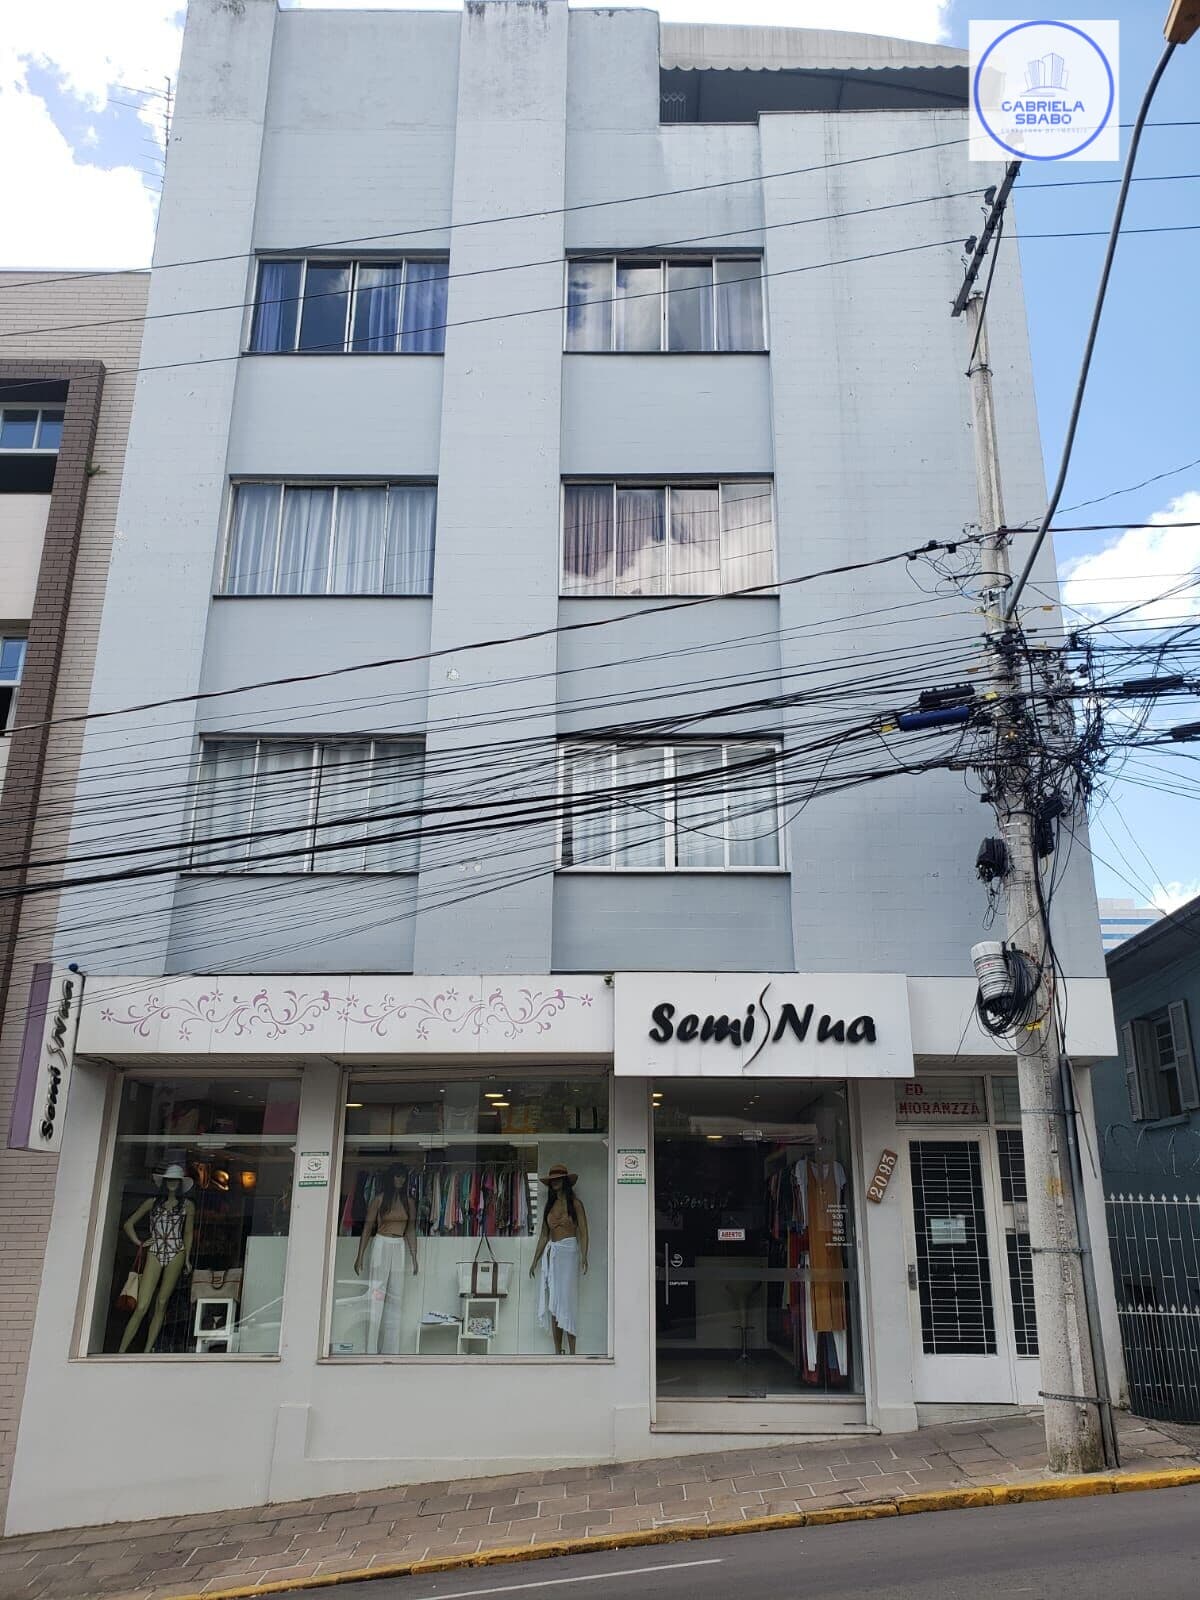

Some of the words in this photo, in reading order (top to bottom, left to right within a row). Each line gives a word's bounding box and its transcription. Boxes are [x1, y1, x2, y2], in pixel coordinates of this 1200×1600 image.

[648, 1002, 756, 1046] Semi
[772, 1003, 877, 1043] Nua
[870, 1153, 896, 1199] 2093
